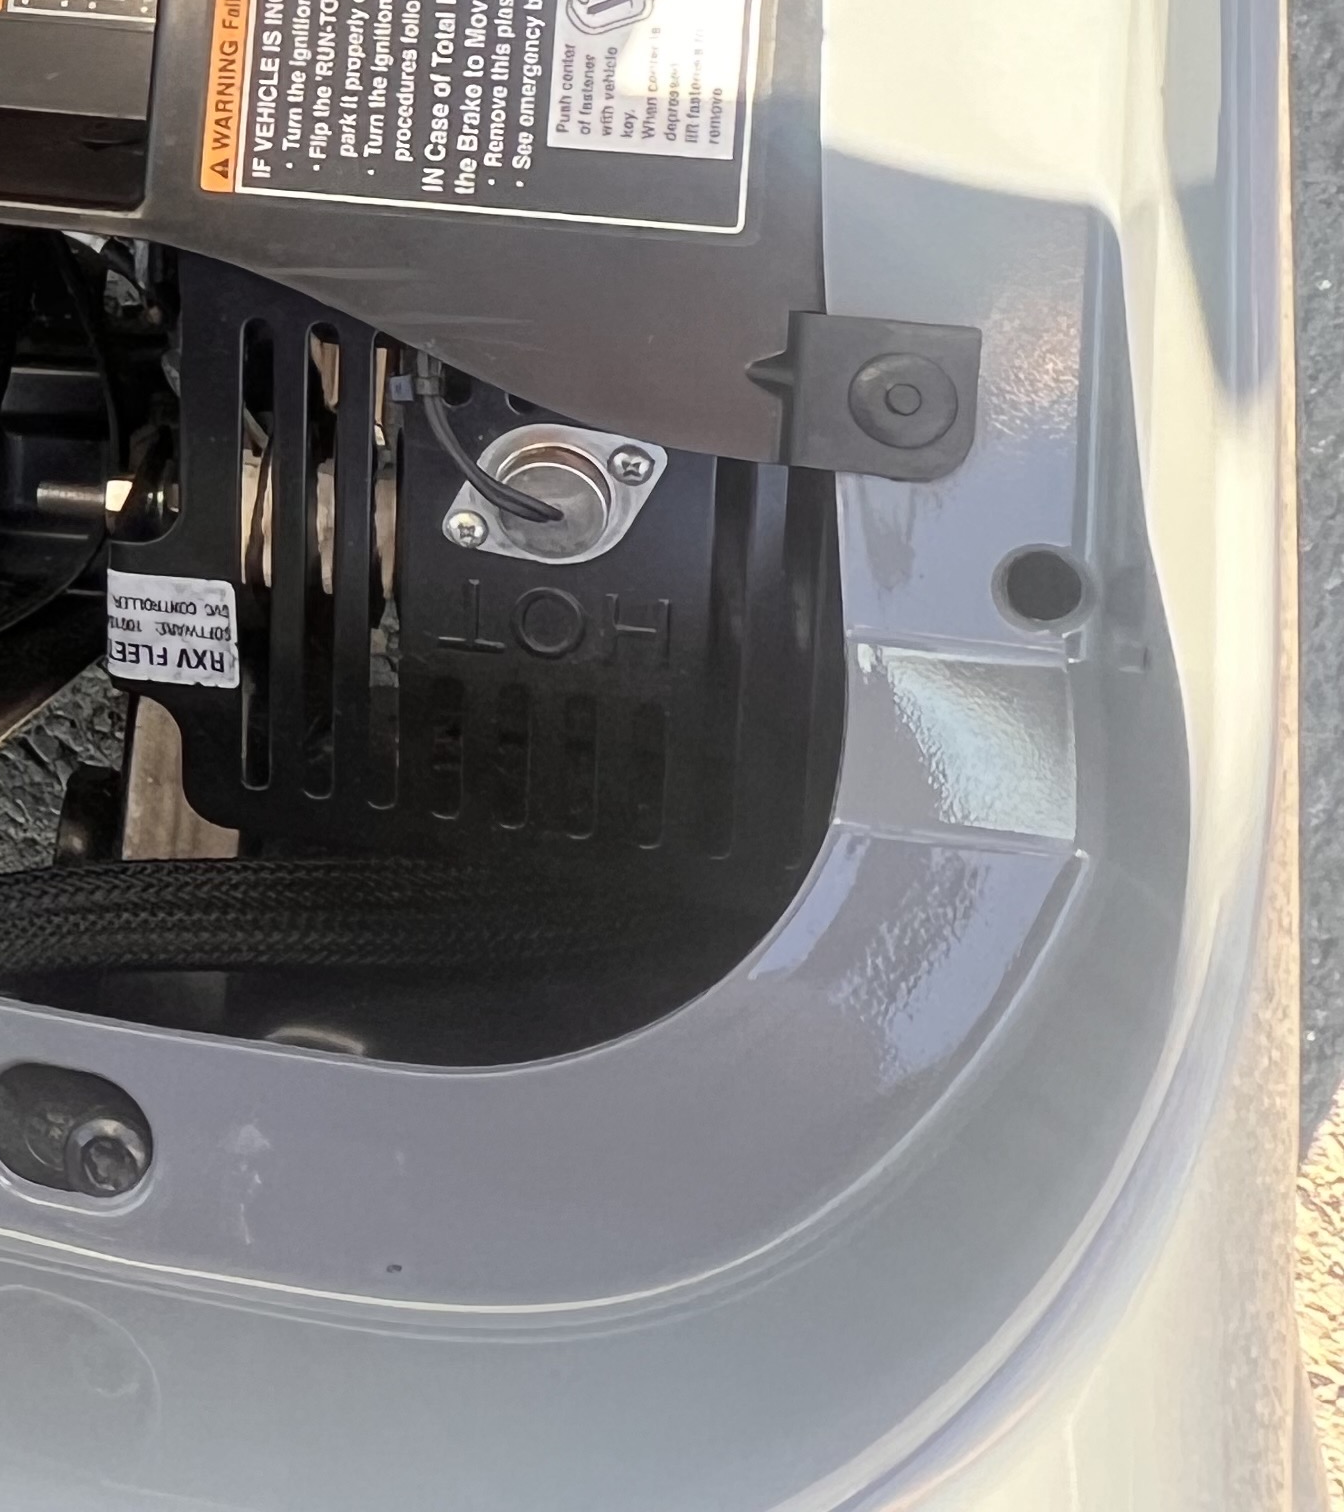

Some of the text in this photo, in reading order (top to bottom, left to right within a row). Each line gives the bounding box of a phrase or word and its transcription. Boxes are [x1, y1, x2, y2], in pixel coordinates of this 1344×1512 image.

[260, 29, 282, 53] IS
[343, 7, 370, 91] properly
[429, 11, 456, 68] Total
[461, 53, 485, 78] to
[489, 42, 511, 81] this
[518, 14, 546, 127] emergency
[210, 39, 239, 151] WARNING
[252, 56, 280, 152] VEHICLE
[285, 69, 307, 103] the
[311, 84, 332, 118] the
[338, 94, 359, 109] it
[366, 75, 388, 108] the
[428, 72, 452, 98] of
[393, 48, 418, 162] procedures
[455, 83, 483, 152] Brake
[280, 106, 303, 151] Turn
[307, 121, 333, 159] Flip
[337, 112, 359, 158] park
[361, 113, 385, 158] Turn
[422, 102, 450, 162] Case
[482, 84, 508, 167] Remove
[250, 156, 272, 178] IF
[510, 130, 534, 170] See
[420, 166, 445, 192] IN
[452, 156, 478, 195] the
[112, 595, 196, 615] CONTROLLER
[438, 578, 672, 668] HOT
[177, 648, 224, 673] RXV
